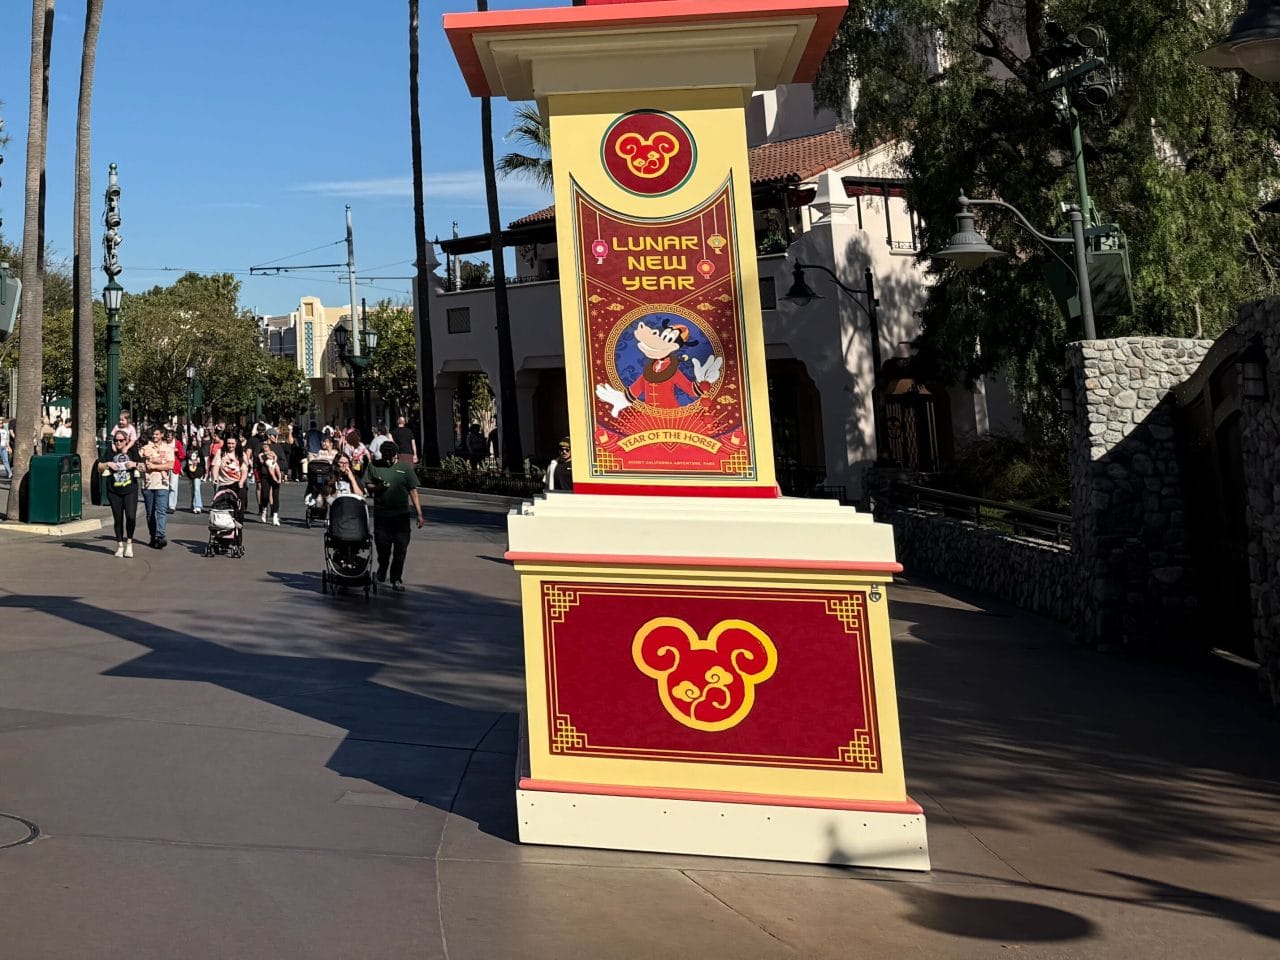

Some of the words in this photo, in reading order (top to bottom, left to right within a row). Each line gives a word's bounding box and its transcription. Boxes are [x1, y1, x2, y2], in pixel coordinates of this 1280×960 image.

[612, 235, 699, 251] LUNAR
[627, 255, 687, 271] NEW
[621, 275, 696, 291] YEAR
[622, 434, 646, 449] YEAR
[647, 432, 661, 441] OF
[661, 431, 681, 440] THE
[683, 433, 718, 451] HORSE
